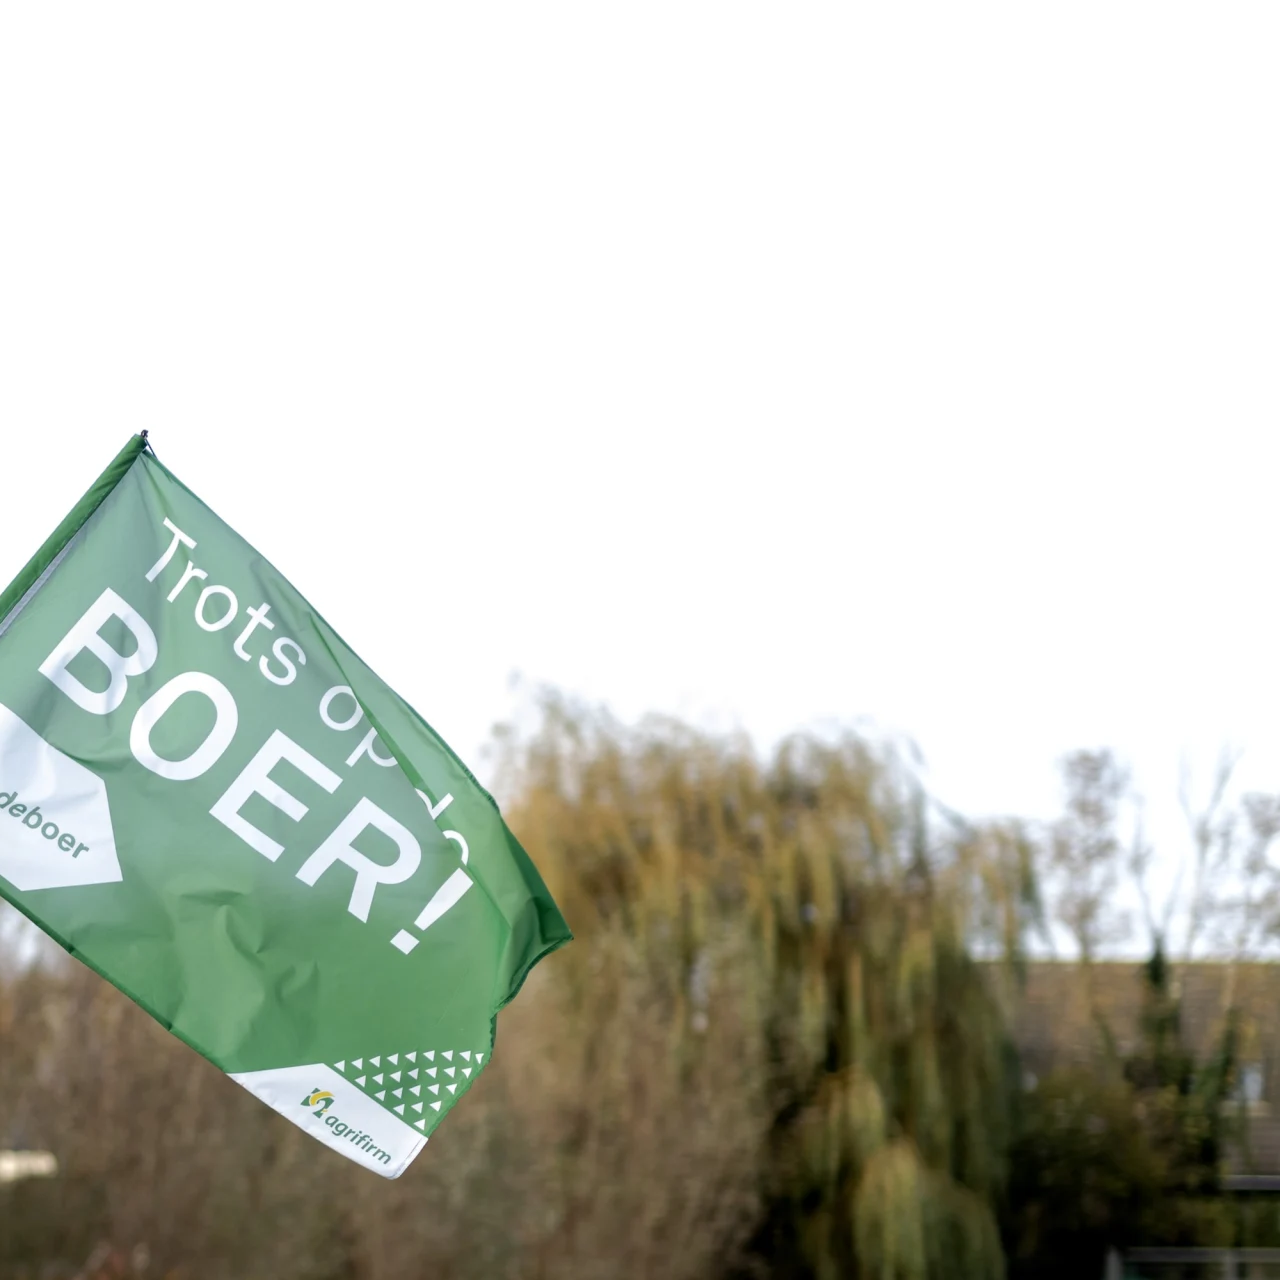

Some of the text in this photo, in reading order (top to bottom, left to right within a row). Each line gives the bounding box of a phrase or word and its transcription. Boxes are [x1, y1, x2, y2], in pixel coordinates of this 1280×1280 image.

[145, 516, 307, 686] Trots
[37, 587, 474, 956] BOER!
[324, 1115, 392, 1165] agrifirm
